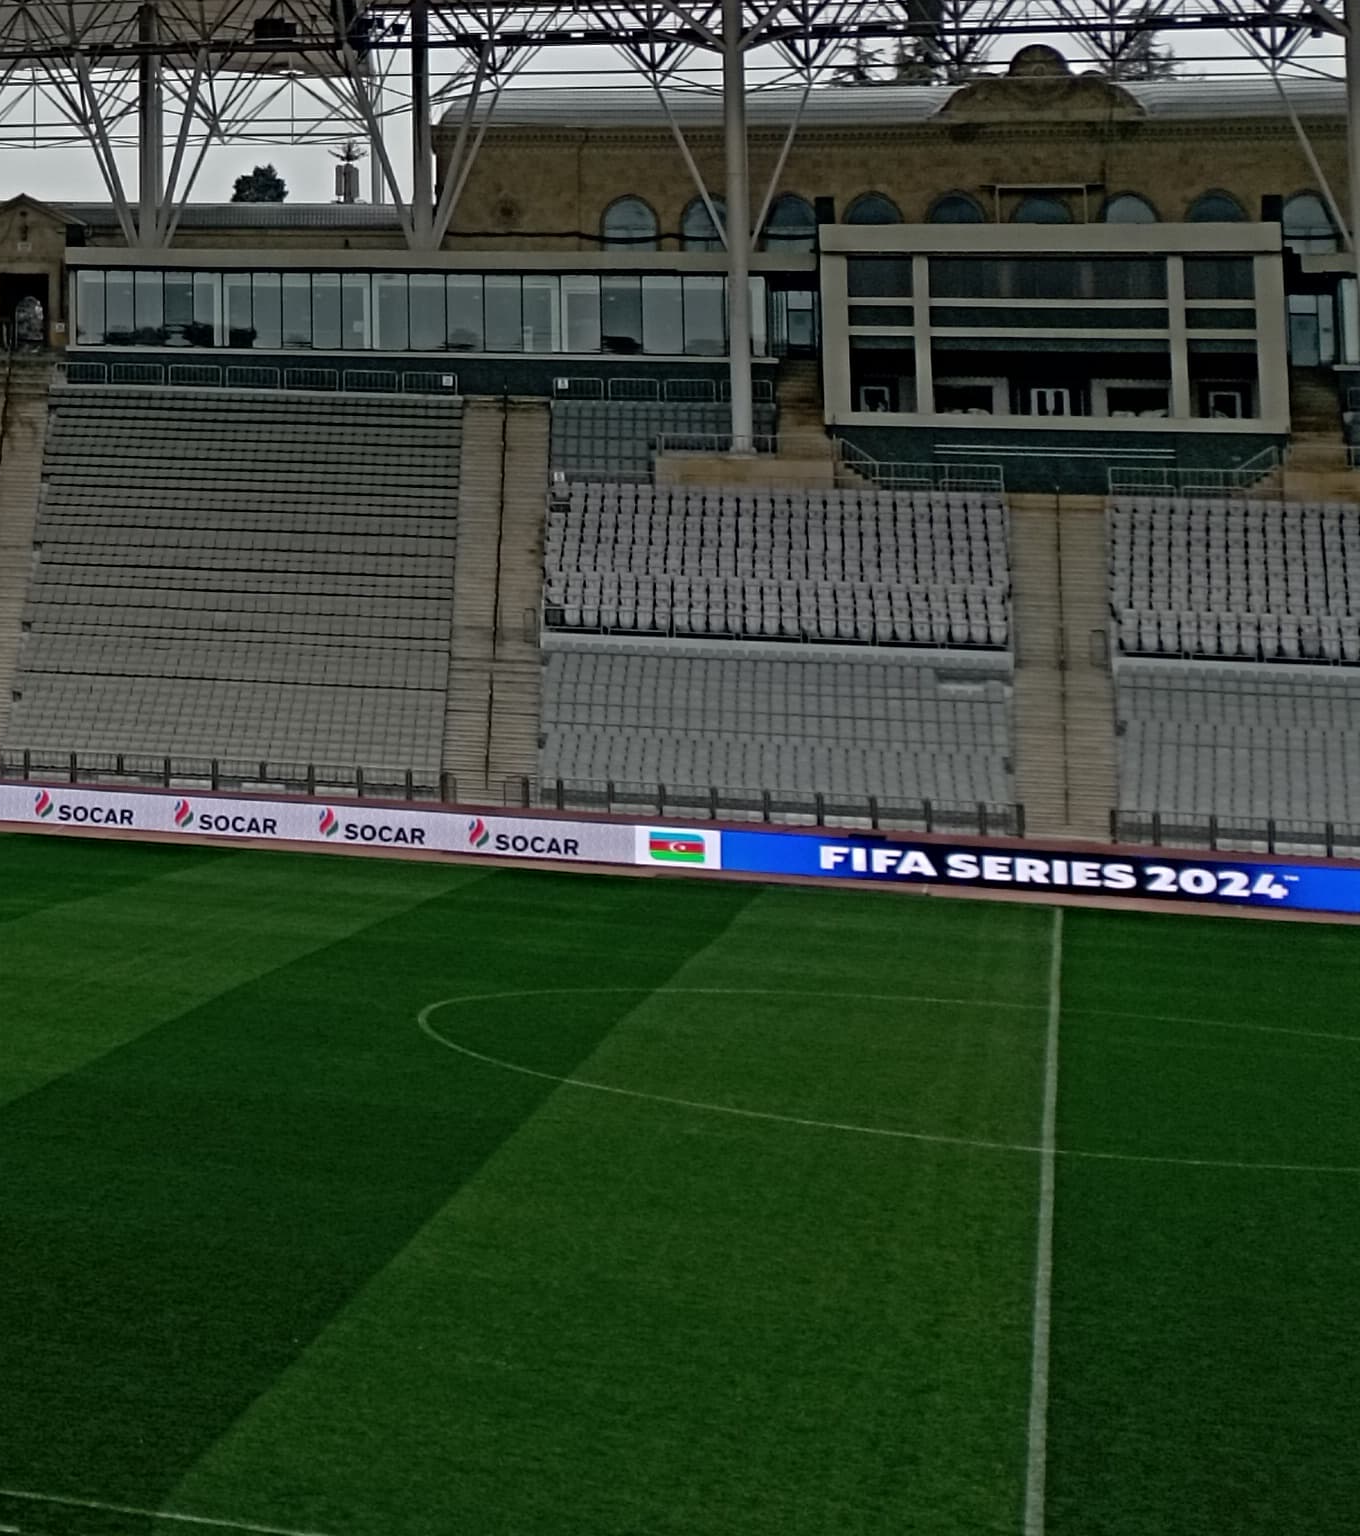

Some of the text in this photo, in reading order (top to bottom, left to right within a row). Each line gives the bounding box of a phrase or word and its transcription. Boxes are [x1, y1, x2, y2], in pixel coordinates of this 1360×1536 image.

[59, 805, 133, 824] SOCAR
[200, 815, 276, 834] SOCAR
[345, 824, 425, 844] SOCAR
[496, 835, 578, 855] SOCAR
[819, 845, 938, 876] FIFA
[946, 853, 1137, 889] SERIES
